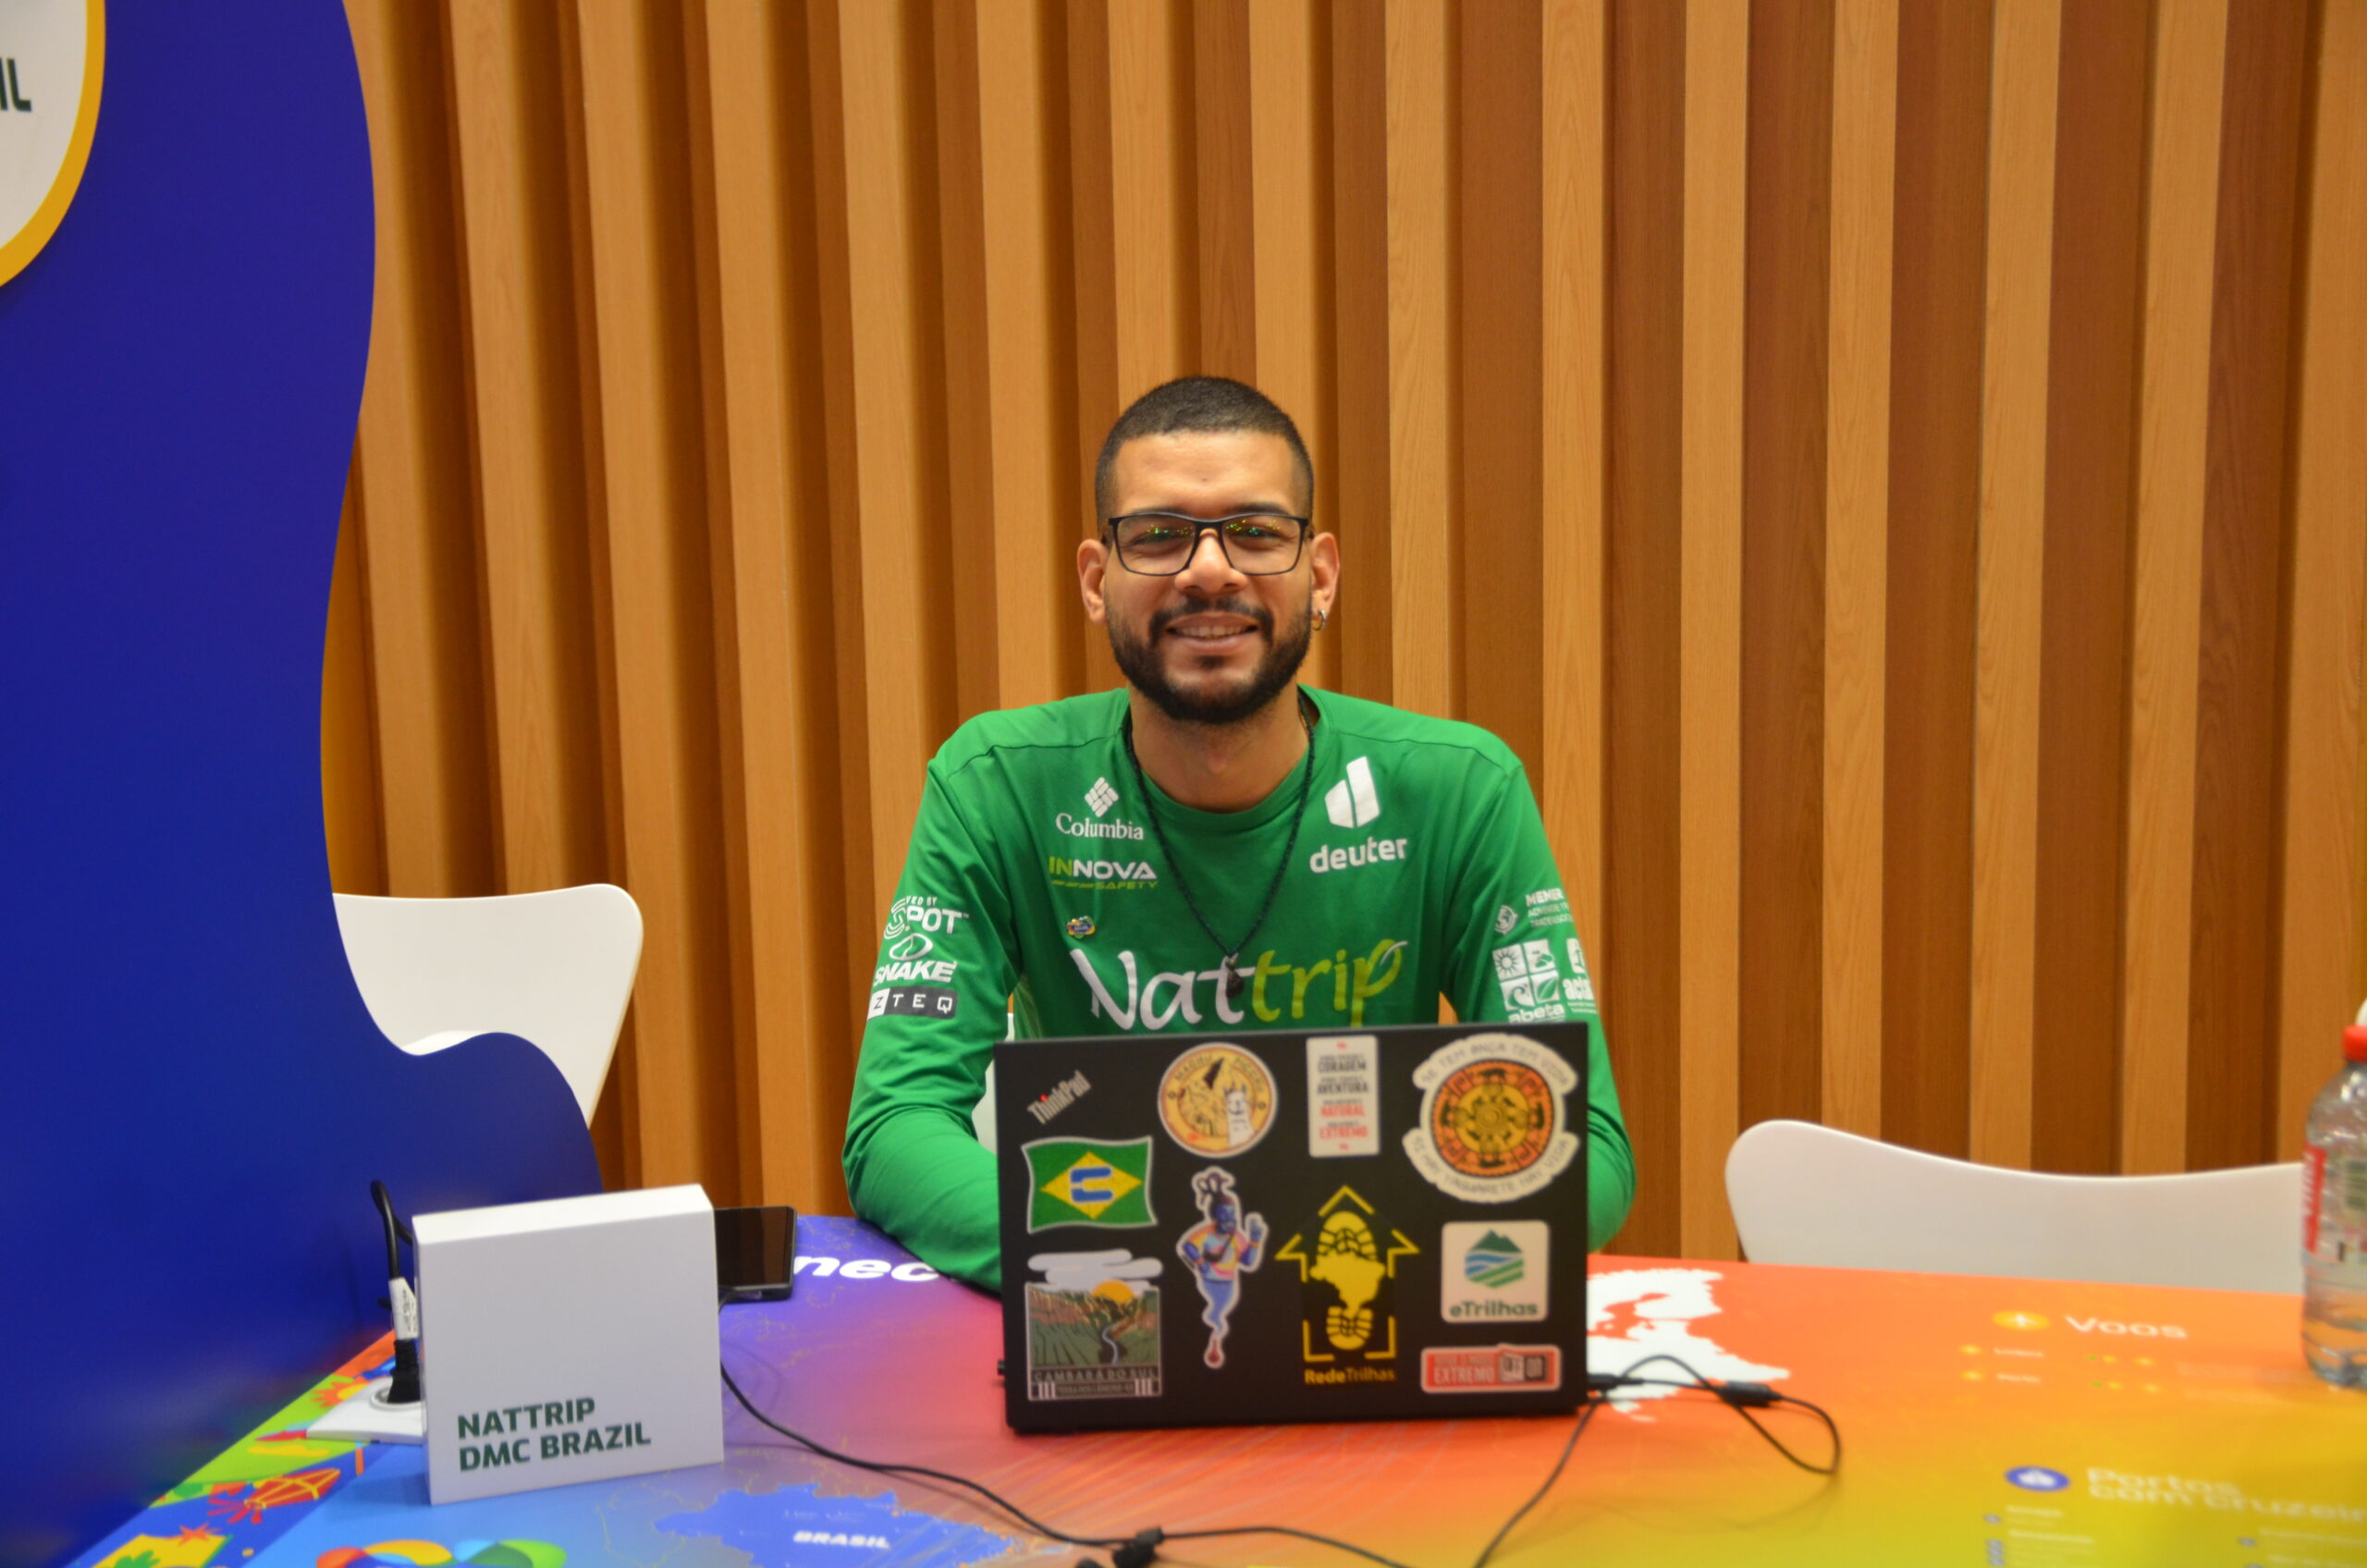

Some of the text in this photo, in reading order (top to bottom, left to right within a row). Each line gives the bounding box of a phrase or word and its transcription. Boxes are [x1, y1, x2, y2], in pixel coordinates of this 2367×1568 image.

[1056, 813, 1145, 840] Columbia
[1049, 856, 1158, 880] INNOVA
[1309, 837, 1408, 874] deuter
[1095, 881, 1159, 890] SAFETY
[873, 960, 958, 986] SNAKE
[1070, 938, 1408, 1031] Nattrip
[1026, 1070, 1091, 1124] ThinkPad
[1450, 1300, 1538, 1317] eTrilhas
[2063, 1313, 2189, 1339] Voos
[458, 1396, 595, 1439] NATTRIP
[460, 1422, 651, 1472] DMC BRAZIL
[793, 1529, 891, 1550] BRASIL
